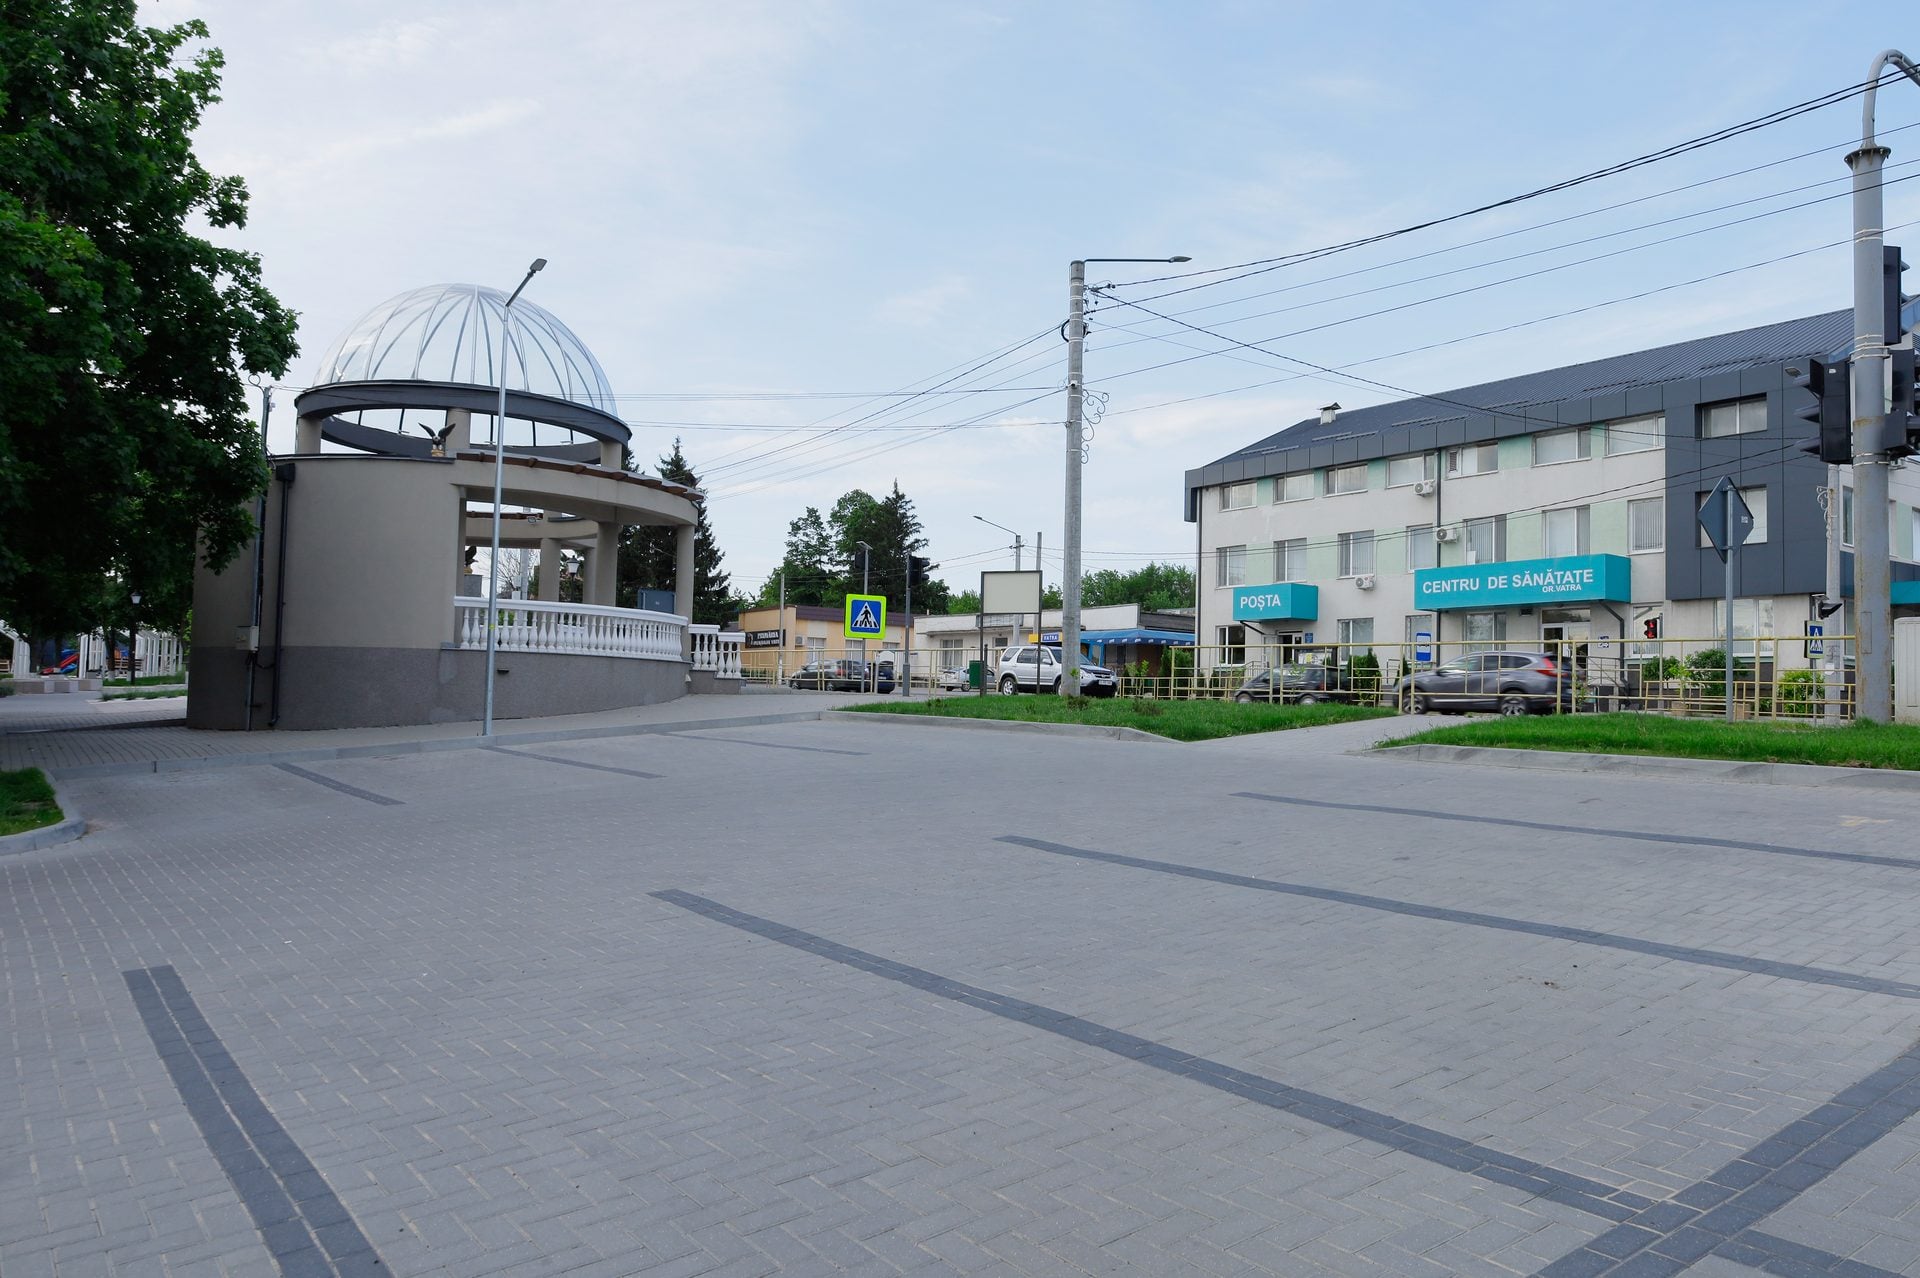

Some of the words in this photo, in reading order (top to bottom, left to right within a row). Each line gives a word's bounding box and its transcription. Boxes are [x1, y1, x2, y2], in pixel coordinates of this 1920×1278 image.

[1422, 577, 1480, 594] CENTRU
[1487, 575, 1509, 590] DE
[1512, 568, 1594, 588] SĂNĂTATE
[1240, 594, 1281, 611] POȘTA
